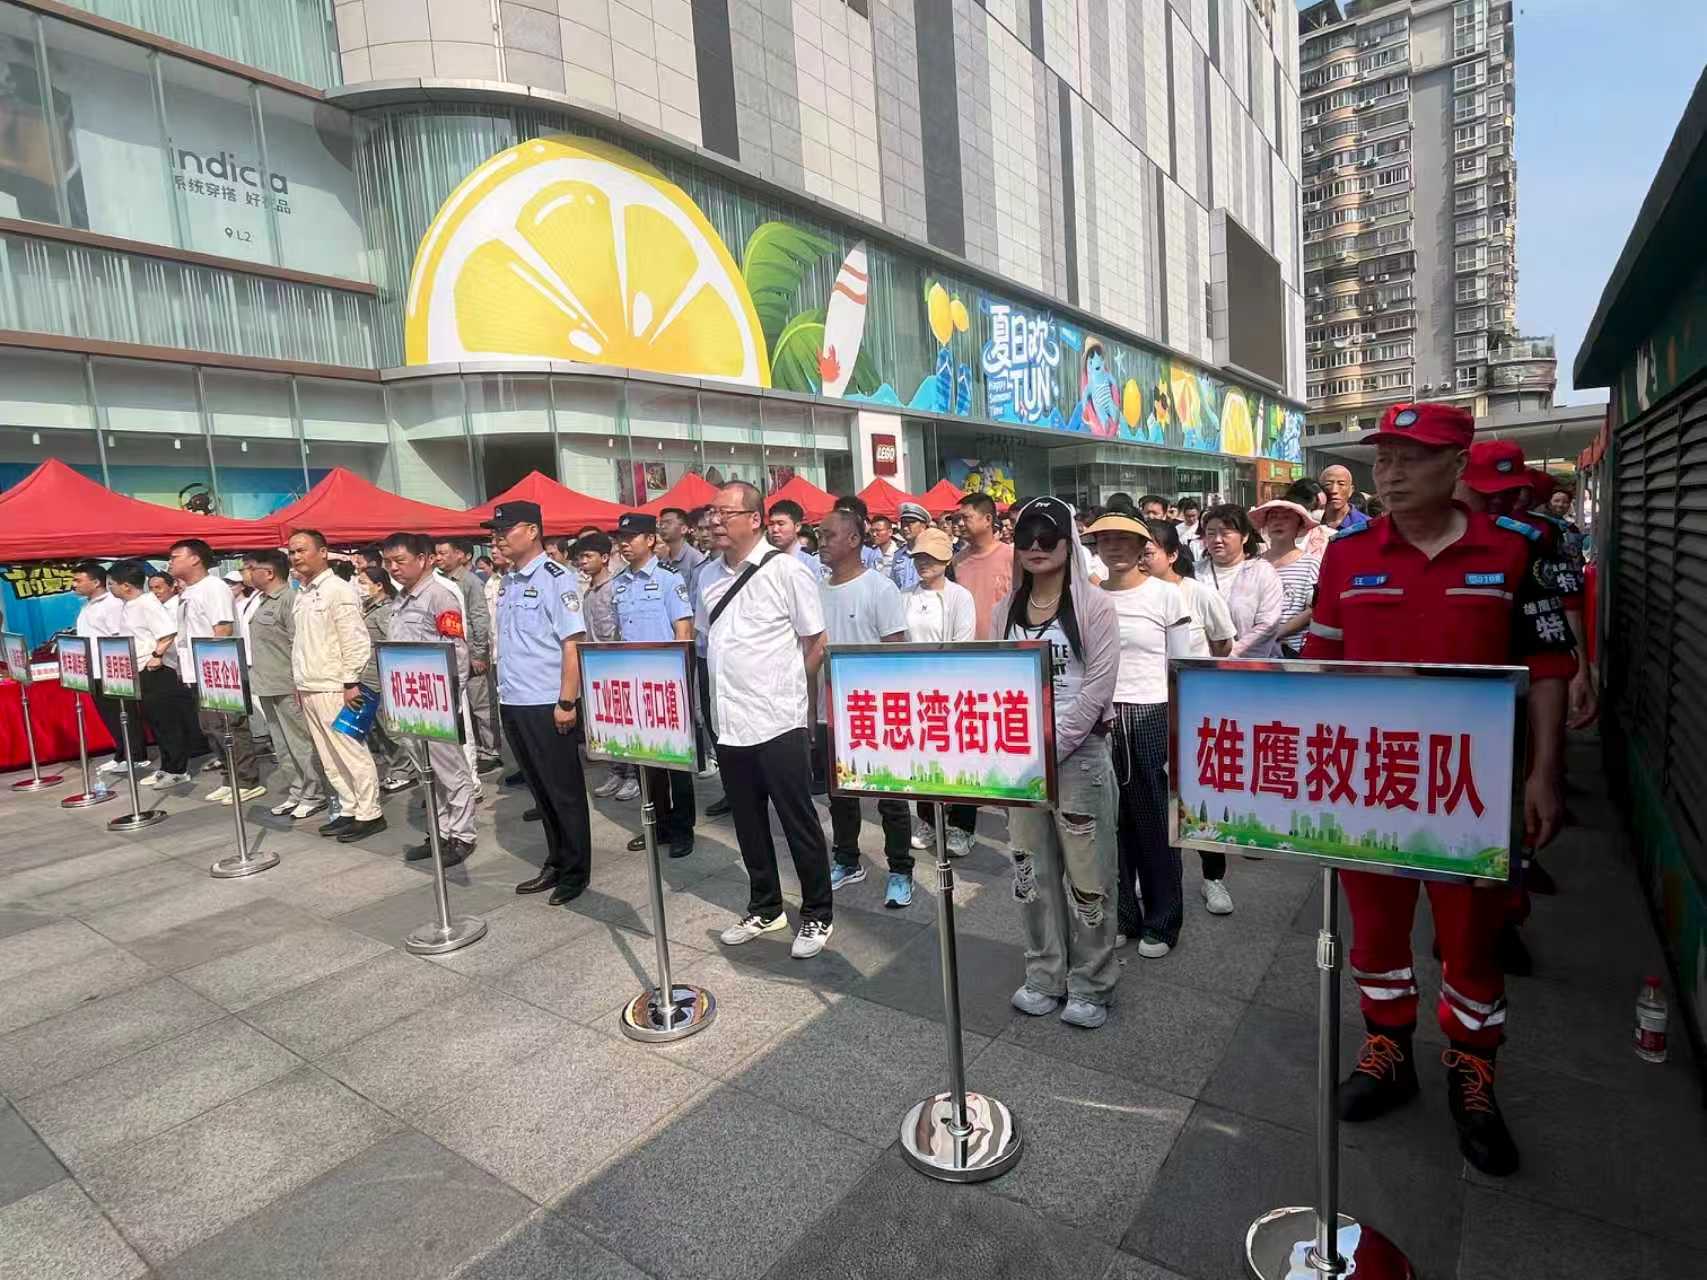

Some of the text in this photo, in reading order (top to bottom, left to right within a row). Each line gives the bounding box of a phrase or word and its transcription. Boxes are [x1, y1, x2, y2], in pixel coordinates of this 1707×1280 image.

[245, 190, 292, 214] 好品
[876, 446, 896, 461] LEGO
[202, 659, 241, 690] 辖区企业
[391, 671, 449, 712] 机关部门
[846, 689, 1032, 755] 黄思湾街道
[1196, 716, 1486, 818] 雄鹰救援队
